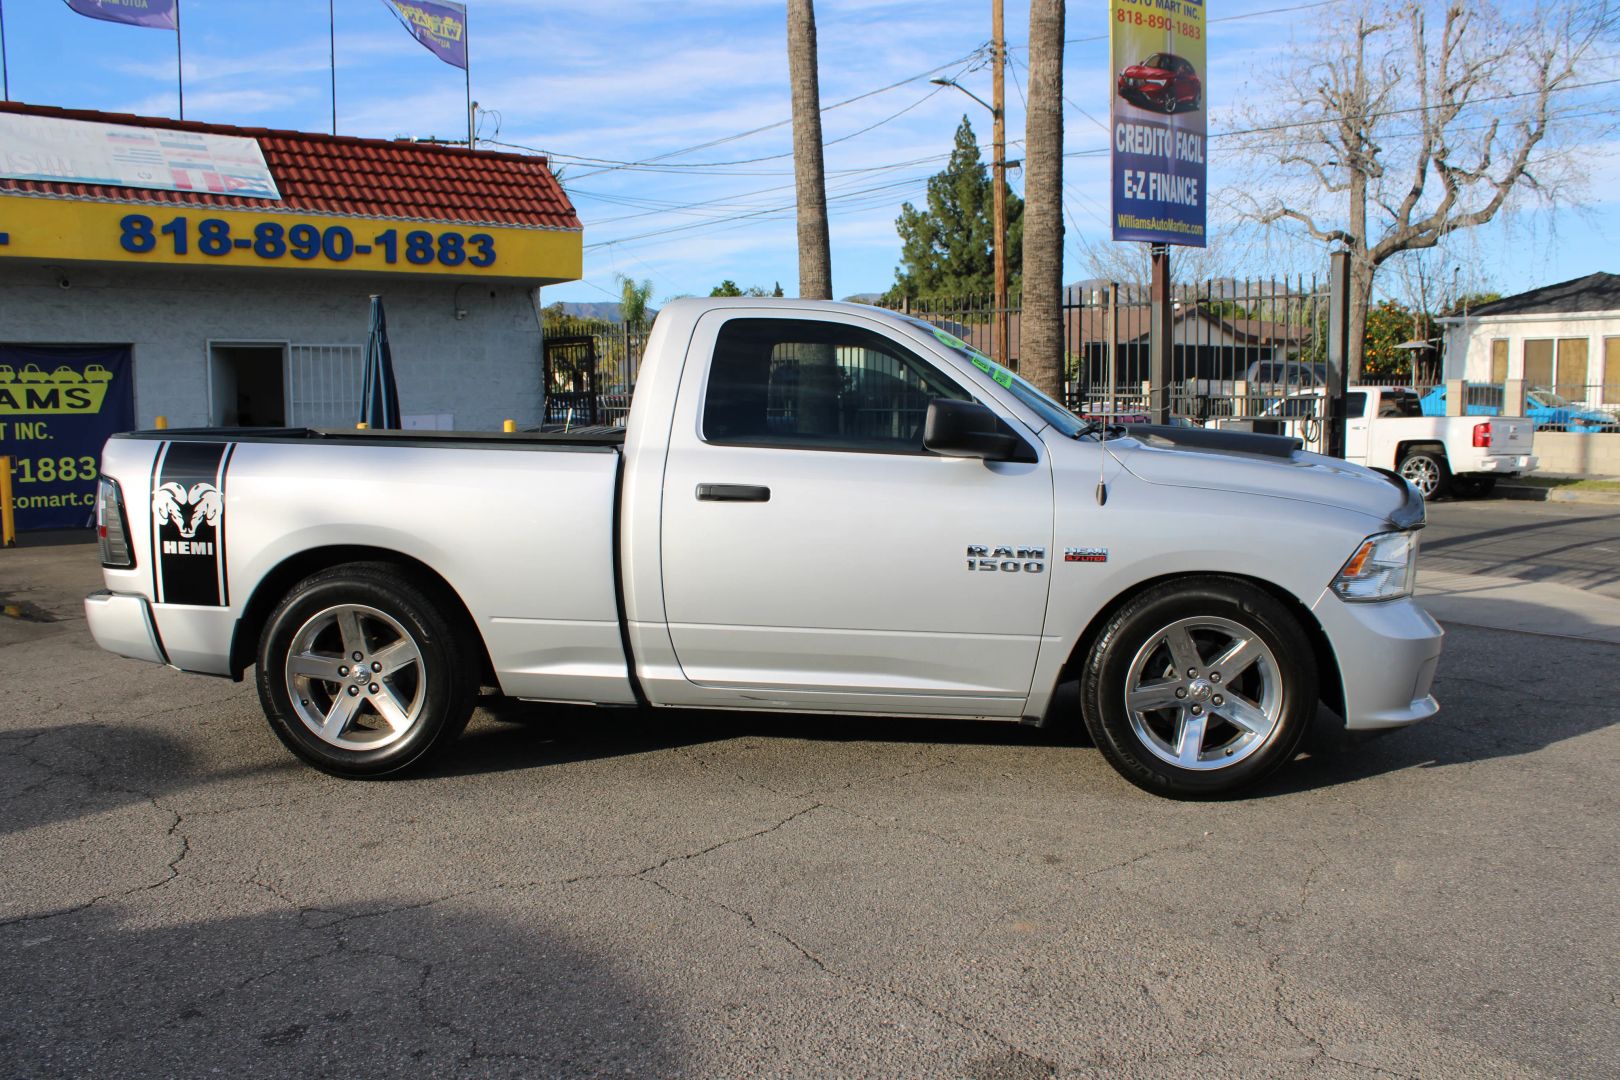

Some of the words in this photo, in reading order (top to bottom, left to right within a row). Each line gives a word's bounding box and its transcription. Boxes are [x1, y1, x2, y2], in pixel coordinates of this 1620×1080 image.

[1184, 4, 1200, 20] INC.
[1117, 8, 1201, 40] 818-890-1883
[1116, 122, 1174, 159] CREDITO
[1176, 130, 1204, 164] FACIL
[1124, 169, 1146, 200] E-Z
[1149, 171, 1198, 207] FINANCE
[119, 214, 497, 268] 818-890-1883
[15, 421, 54, 440] INC.
[163, 540, 213, 556] HEMI
[966, 544, 1046, 560] RAM
[966, 559, 1045, 573] 1500
